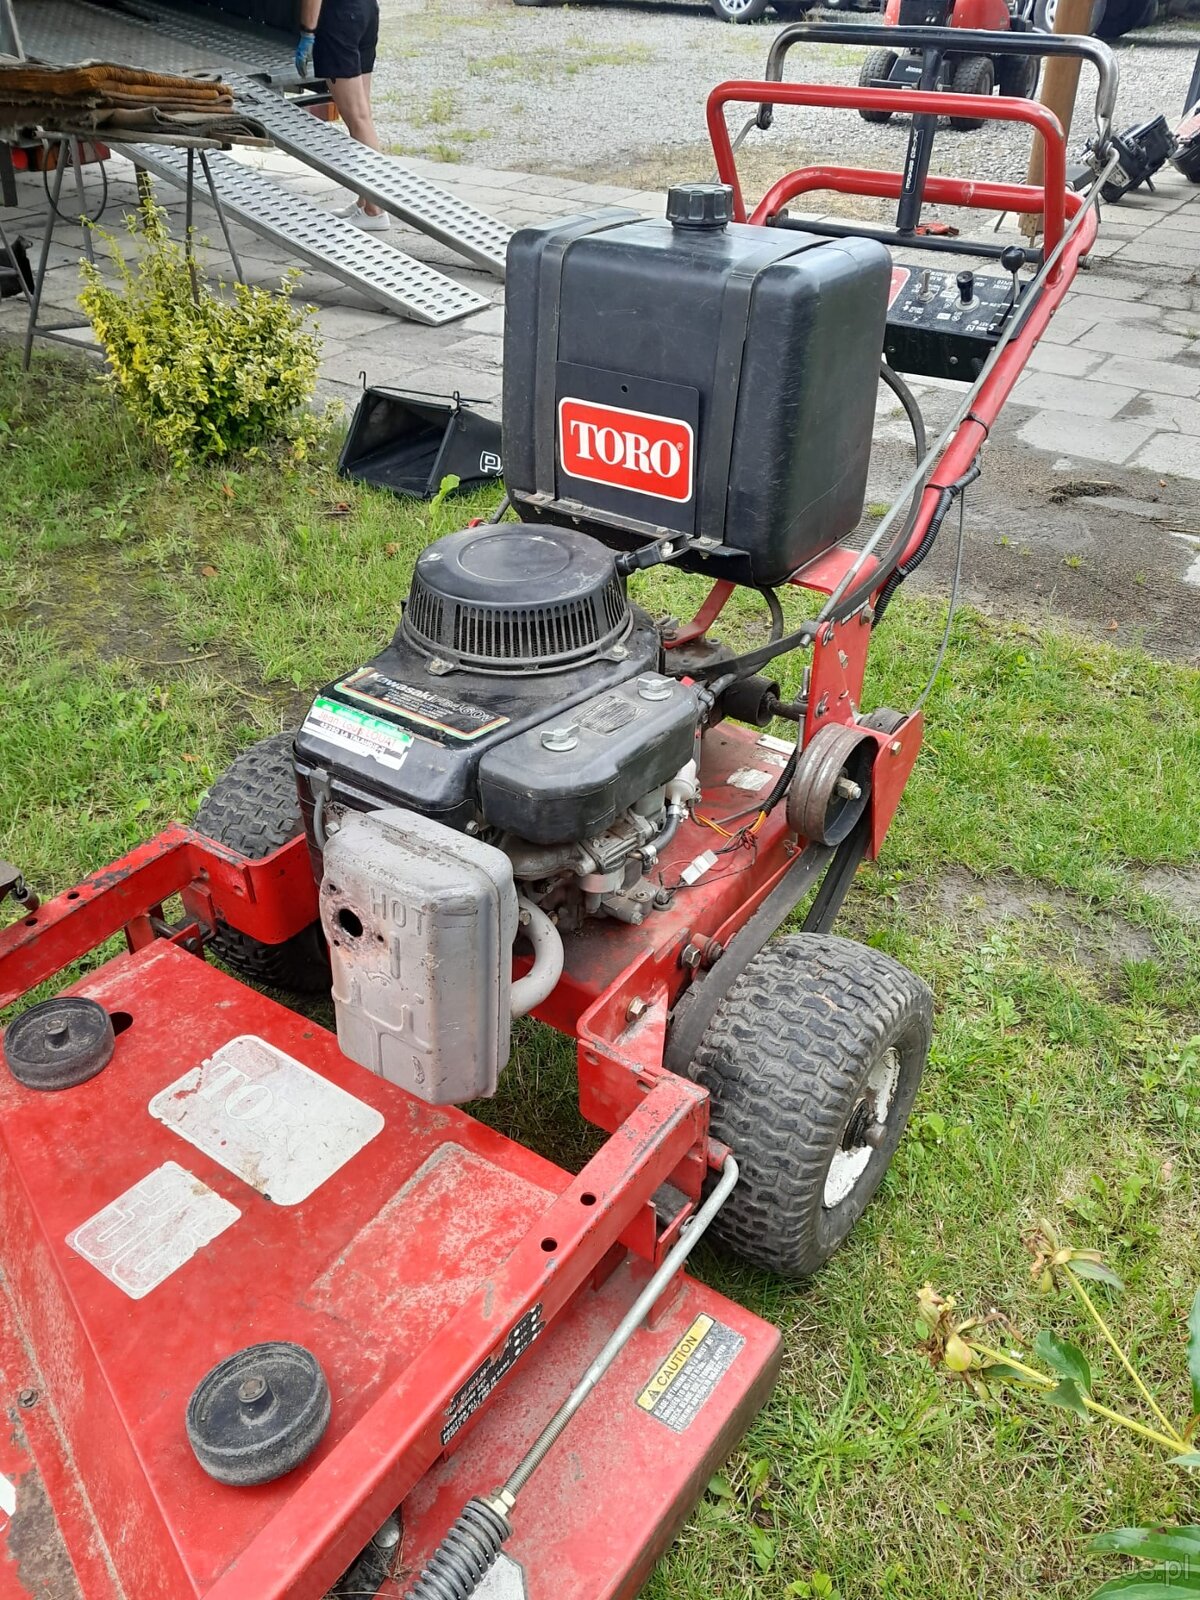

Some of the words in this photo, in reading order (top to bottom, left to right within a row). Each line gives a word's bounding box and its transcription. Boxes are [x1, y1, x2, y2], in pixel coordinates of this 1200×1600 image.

[570, 419, 682, 478] TORO
[367, 672, 438, 703] Kawasaki
[369, 887, 426, 936] HOT
[657, 1336, 698, 1386] CAUTION
